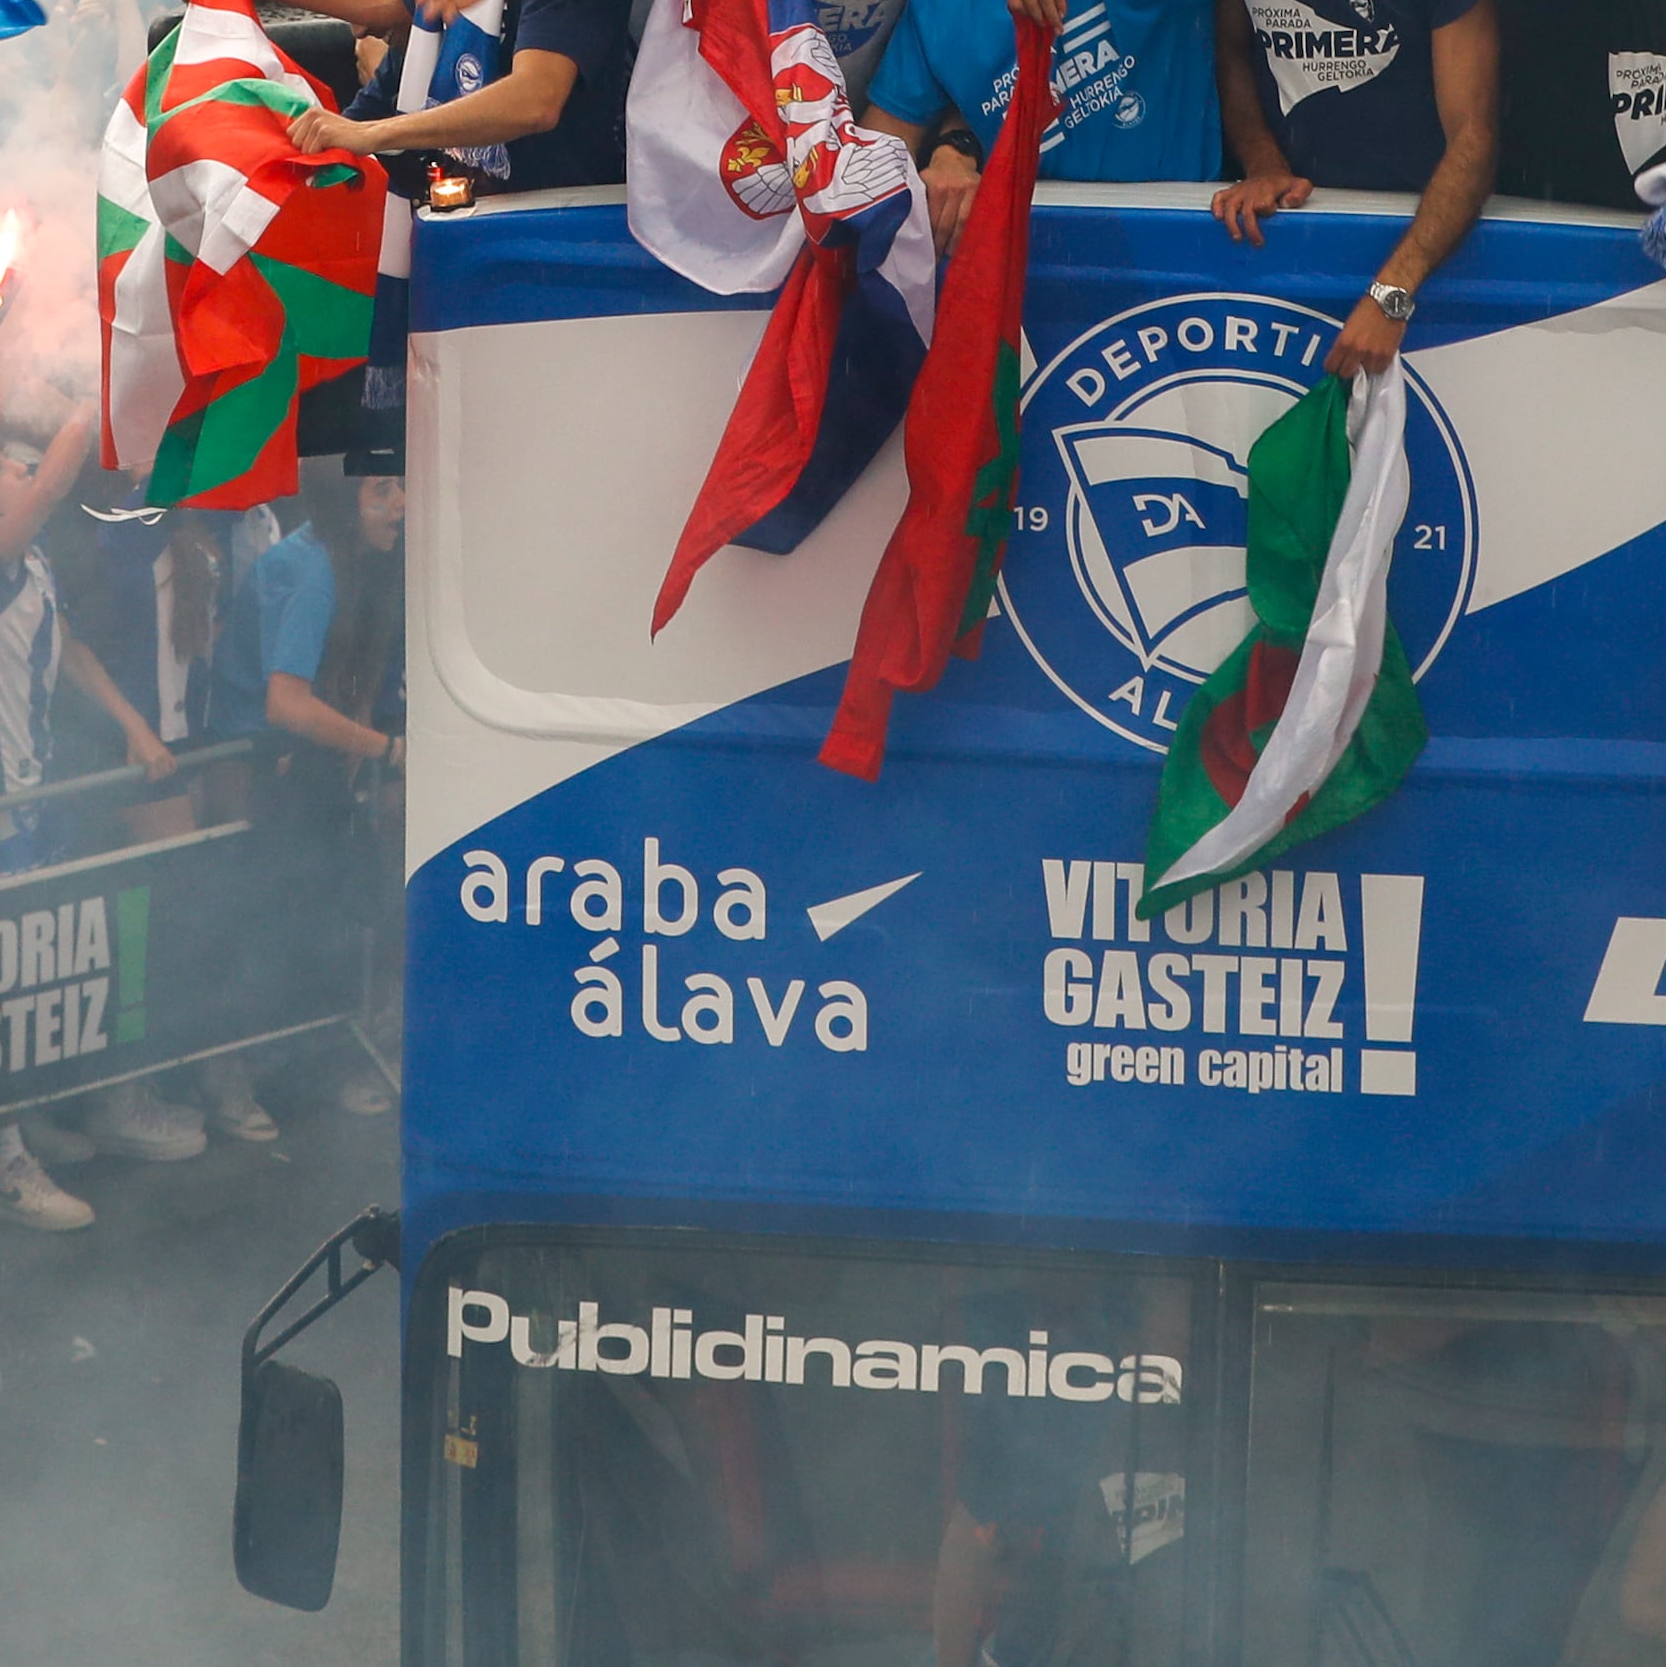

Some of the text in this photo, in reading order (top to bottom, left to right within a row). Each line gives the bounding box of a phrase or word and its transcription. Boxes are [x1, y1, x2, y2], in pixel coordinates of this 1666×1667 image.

[1252, 6, 1302, 19] PRÓXIMA
[1265, 17, 1312, 29] PARADA
[1255, 26, 1401, 60] PRIMERA
[1069, 54, 1136, 111] HURRENGO
[1301, 59, 1367, 73] HURRENGO
[1317, 67, 1375, 82] GELTOKIA
[980, 84, 1017, 117] PARA
[1063, 85, 1125, 130] GELTOKIA
[1066, 315, 1322, 407] DEPORTI
[1013, 505, 1050, 532] 19
[1413, 524, 1447, 551] 21
[459, 836, 767, 941] araba
[1041, 858, 1349, 953] VITORIA
[569, 935, 868, 1053] álava
[1043, 947, 1346, 1041] GASTEIZ
[1066, 1042, 1344, 1095] green capital
